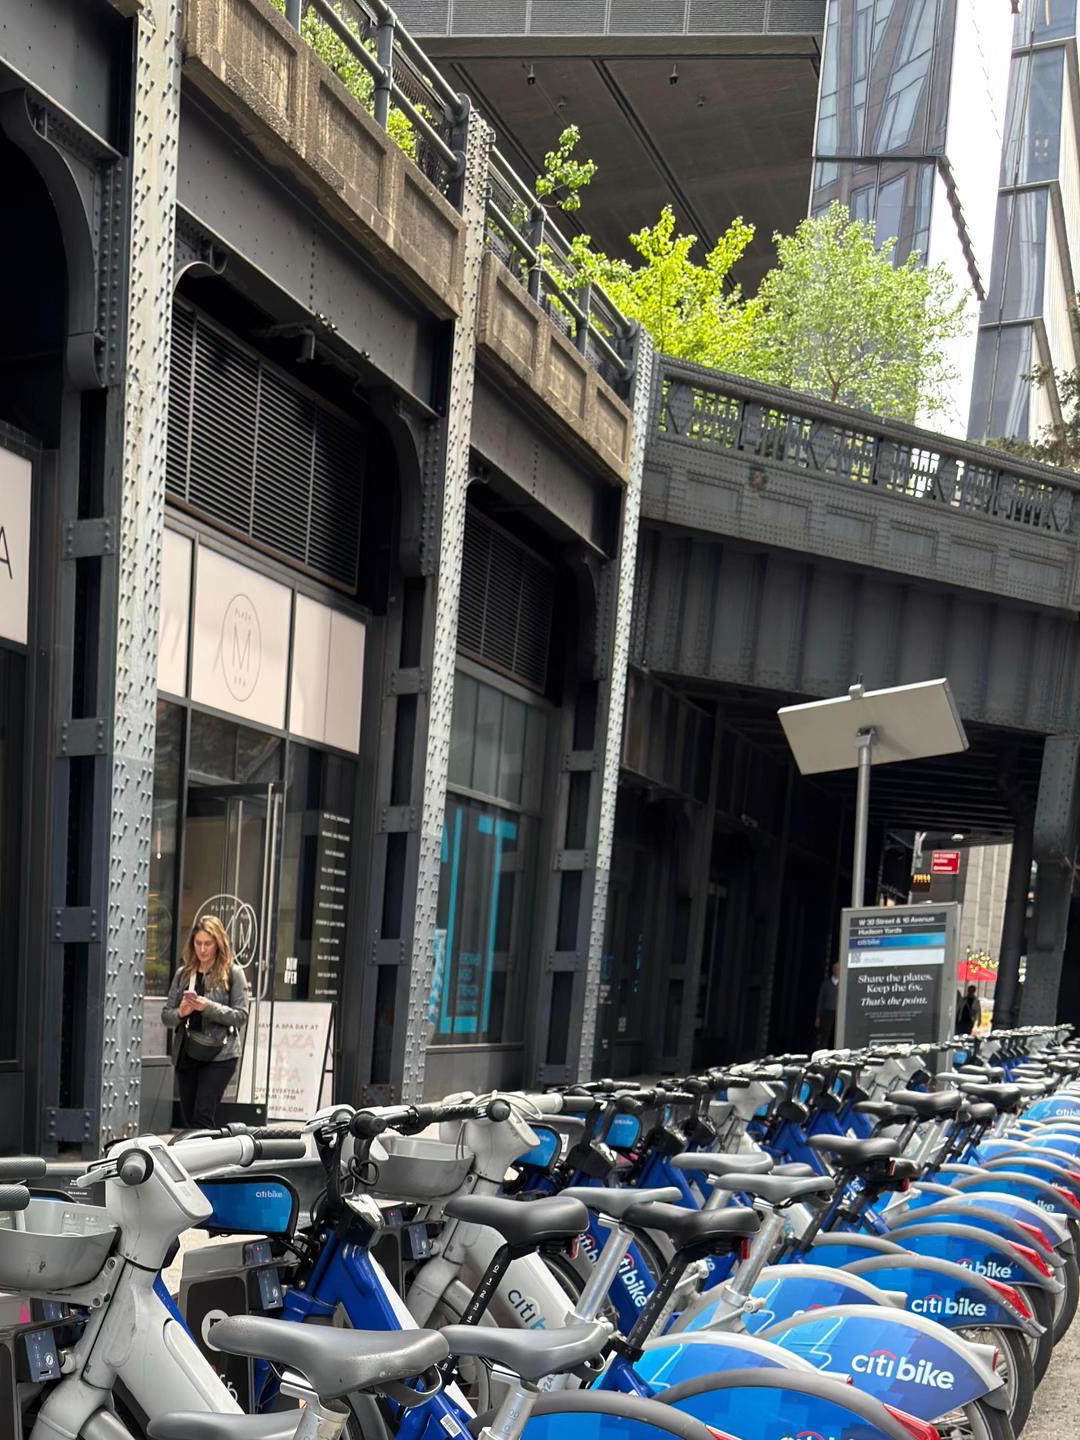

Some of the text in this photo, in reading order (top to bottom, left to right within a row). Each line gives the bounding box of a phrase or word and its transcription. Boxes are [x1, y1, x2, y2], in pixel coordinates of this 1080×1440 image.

[858, 973, 885, 984] Share
[886, 972, 901, 982] the
[866, 983, 890, 994] Keep
[891, 983, 907, 992] the
[887, 996, 900, 1006] the
[257, 1033, 315, 1048] PAZA
[267, 1190, 283, 1199] bike
[974, 1261, 1012, 1278] bike
[621, 1269, 648, 1308] bike
[507, 1288, 538, 1323] citi
[911, 1295, 987, 1316] citi bike
[851, 1351, 955, 1391] citi bike
